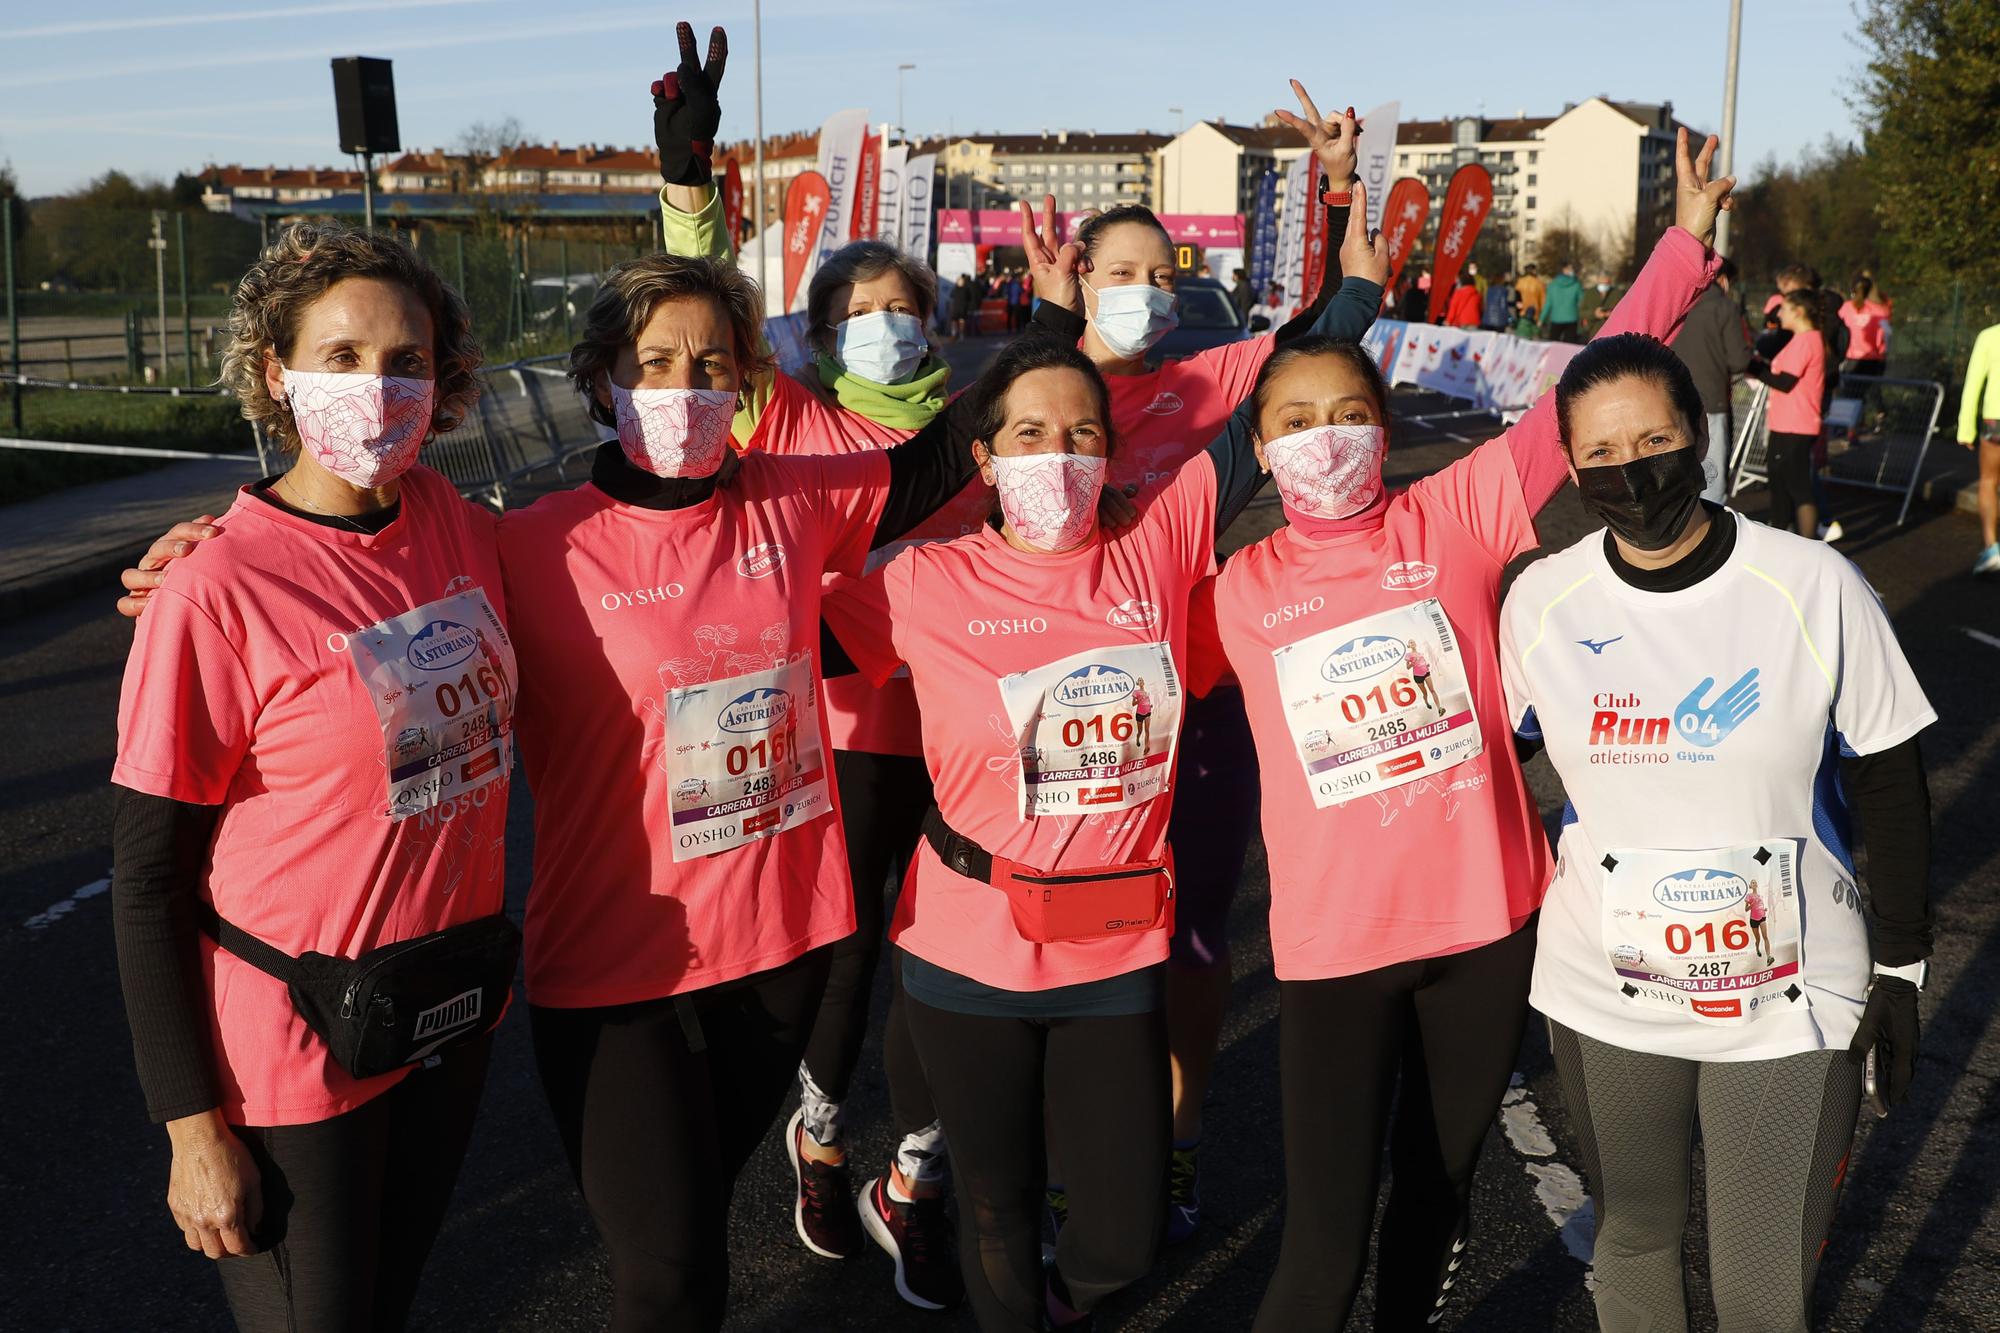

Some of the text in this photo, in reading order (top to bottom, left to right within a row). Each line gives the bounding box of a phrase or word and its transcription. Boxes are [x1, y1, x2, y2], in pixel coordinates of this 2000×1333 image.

[822, 155, 847, 238] ZURICH
[1368, 154, 1385, 224] URICH
[601, 583, 684, 611] OYSHO
[1263, 596, 1324, 629] OYSHO
[968, 617, 1047, 636] OYSHO
[414, 634, 475, 667] ASTURIANA
[1330, 647, 1401, 678] ASTURIANA
[435, 666, 499, 717] 016
[1061, 681, 1131, 700] ASTURIANA
[1341, 677, 1417, 723] 016
[1593, 692, 1641, 708] Club
[462, 712, 489, 738] 248
[724, 701, 787, 728] ASTURIANA
[1062, 713, 1133, 747] 016
[1367, 718, 1407, 742] 2485
[1588, 711, 1721, 745] Run 04
[428, 741, 472, 767] CARRERA
[473, 733, 485, 748] DE
[726, 732, 786, 776] 016
[1338, 744, 1383, 764] CARRERA
[1384, 736, 1399, 749] DE
[1400, 731, 1415, 745] LA
[1415, 720, 1449, 741] MUJER
[1590, 749, 1715, 765] atletismo Gijón
[1041, 770, 1089, 782] CARRERA
[1091, 768, 1105, 778] DE
[1107, 766, 1120, 777] LA
[1080, 751, 1117, 767] 2486
[1319, 770, 1372, 796] OYSHO
[1390, 757, 1418, 773] Santander
[1444, 737, 1473, 753] ZURICH
[397, 771, 453, 805] OYSHO
[706, 776, 804, 817] CARRERA DE LA MUJER
[744, 775, 777, 796] 2483
[1026, 790, 1070, 804] YSHO
[1136, 776, 1160, 790] ZURICH
[680, 824, 736, 849] OYSHO
[797, 794, 821, 811] ZURICH
[1660, 884, 1743, 902] ASTURIANA
[1664, 919, 1750, 955] 016
[1649, 970, 1774, 991] CARRERA DE LA MUJER
[1687, 961, 1731, 978] 2487
[418, 991, 480, 1036] PUMA
[1703, 1005, 1735, 1013] Santander
[1760, 990, 1785, 1004] ZURIC
